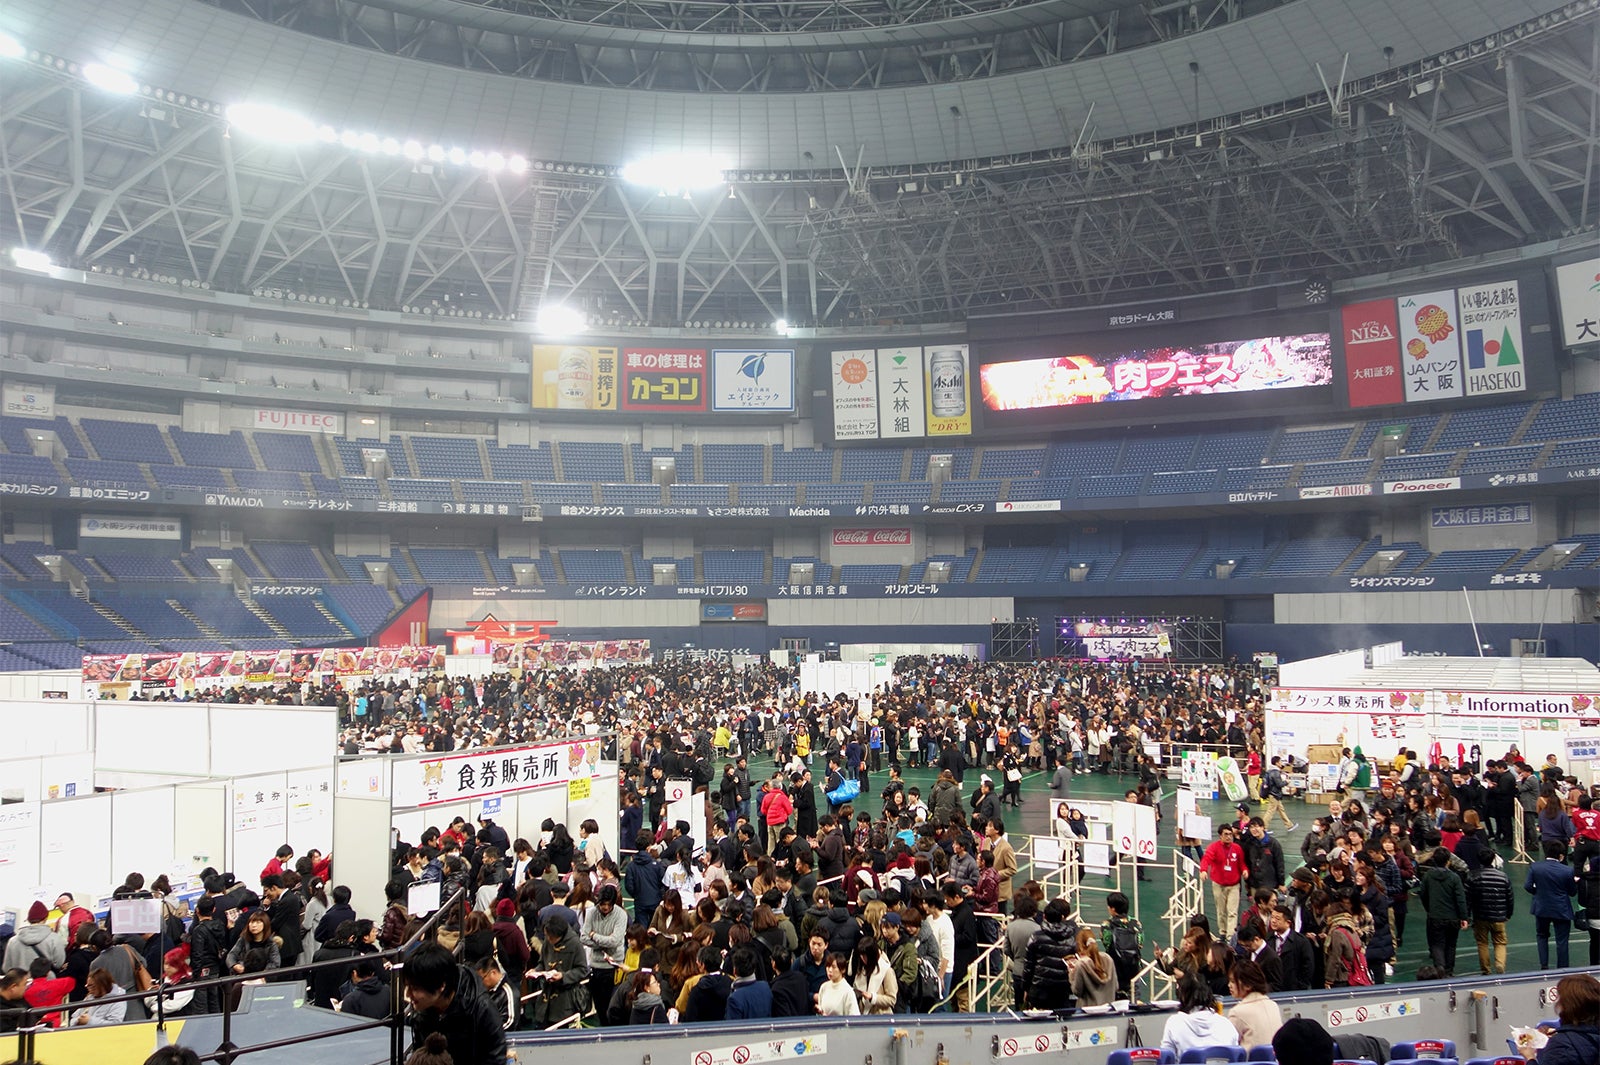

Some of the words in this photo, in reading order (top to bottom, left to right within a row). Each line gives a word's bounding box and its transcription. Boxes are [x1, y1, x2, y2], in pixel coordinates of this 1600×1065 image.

[1109, 311, 1155, 326] 京セラドーム
[1156, 310, 1175, 322] 大阪
[1351, 324, 1393, 342] NISA
[1576, 318, 1600, 340] 大
[627, 353, 703, 369] 車の修理は
[1113, 355, 1239, 392] 肉フェス
[1353, 365, 1395, 380] 大和証券
[1407, 360, 1458, 376] JAバンク
[597, 349, 614, 407] 一番搾り
[934, 374, 963, 389] Asahi
[1413, 373, 1454, 393] 大阪
[1470, 370, 1521, 392] HASEKO
[631, 376, 698, 401] カーコン
[727, 392, 779, 401] エイジェック
[892, 377, 911, 433] 大林組
[258, 410, 334, 428] FUJITEC
[859, 422, 876, 430] トップ
[1505, 473, 1538, 484] 伊藤園
[1302, 489, 1332, 497] アミューズ
[1333, 485, 1367, 497] AMUSE
[1392, 482, 1452, 492] Pioneer
[70, 487, 150, 500] 振動のエミック
[1229, 492, 1278, 502] 日立バッテリー
[216, 494, 264, 507] YAMADA
[307, 499, 353, 511] テレネット
[377, 502, 418, 513] 三井造船
[455, 503, 509, 515] 東海建物
[714, 507, 770, 517] さつき株式会社
[789, 507, 830, 517] Machida
[868, 505, 910, 515] 内外電機
[955, 504, 985, 513] CX-3
[1434, 505, 1530, 526] 大阪信用金庫
[1350, 577, 1435, 587] ライオンズマンション
[1490, 573, 1542, 584] ホーチキ
[587, 586, 647, 596] パインランド
[705, 586, 748, 596] バブル90
[777, 585, 848, 596] 大阪信用金庫
[885, 584, 939, 594] オリオンビール
[1112, 625, 1148, 634] 肉フェス
[1295, 694, 1385, 709] グッズ販売所
[1467, 697, 1569, 713] Information
[1572, 748, 1598, 756] 最後尾
[457, 752, 559, 792] 食券販売所
